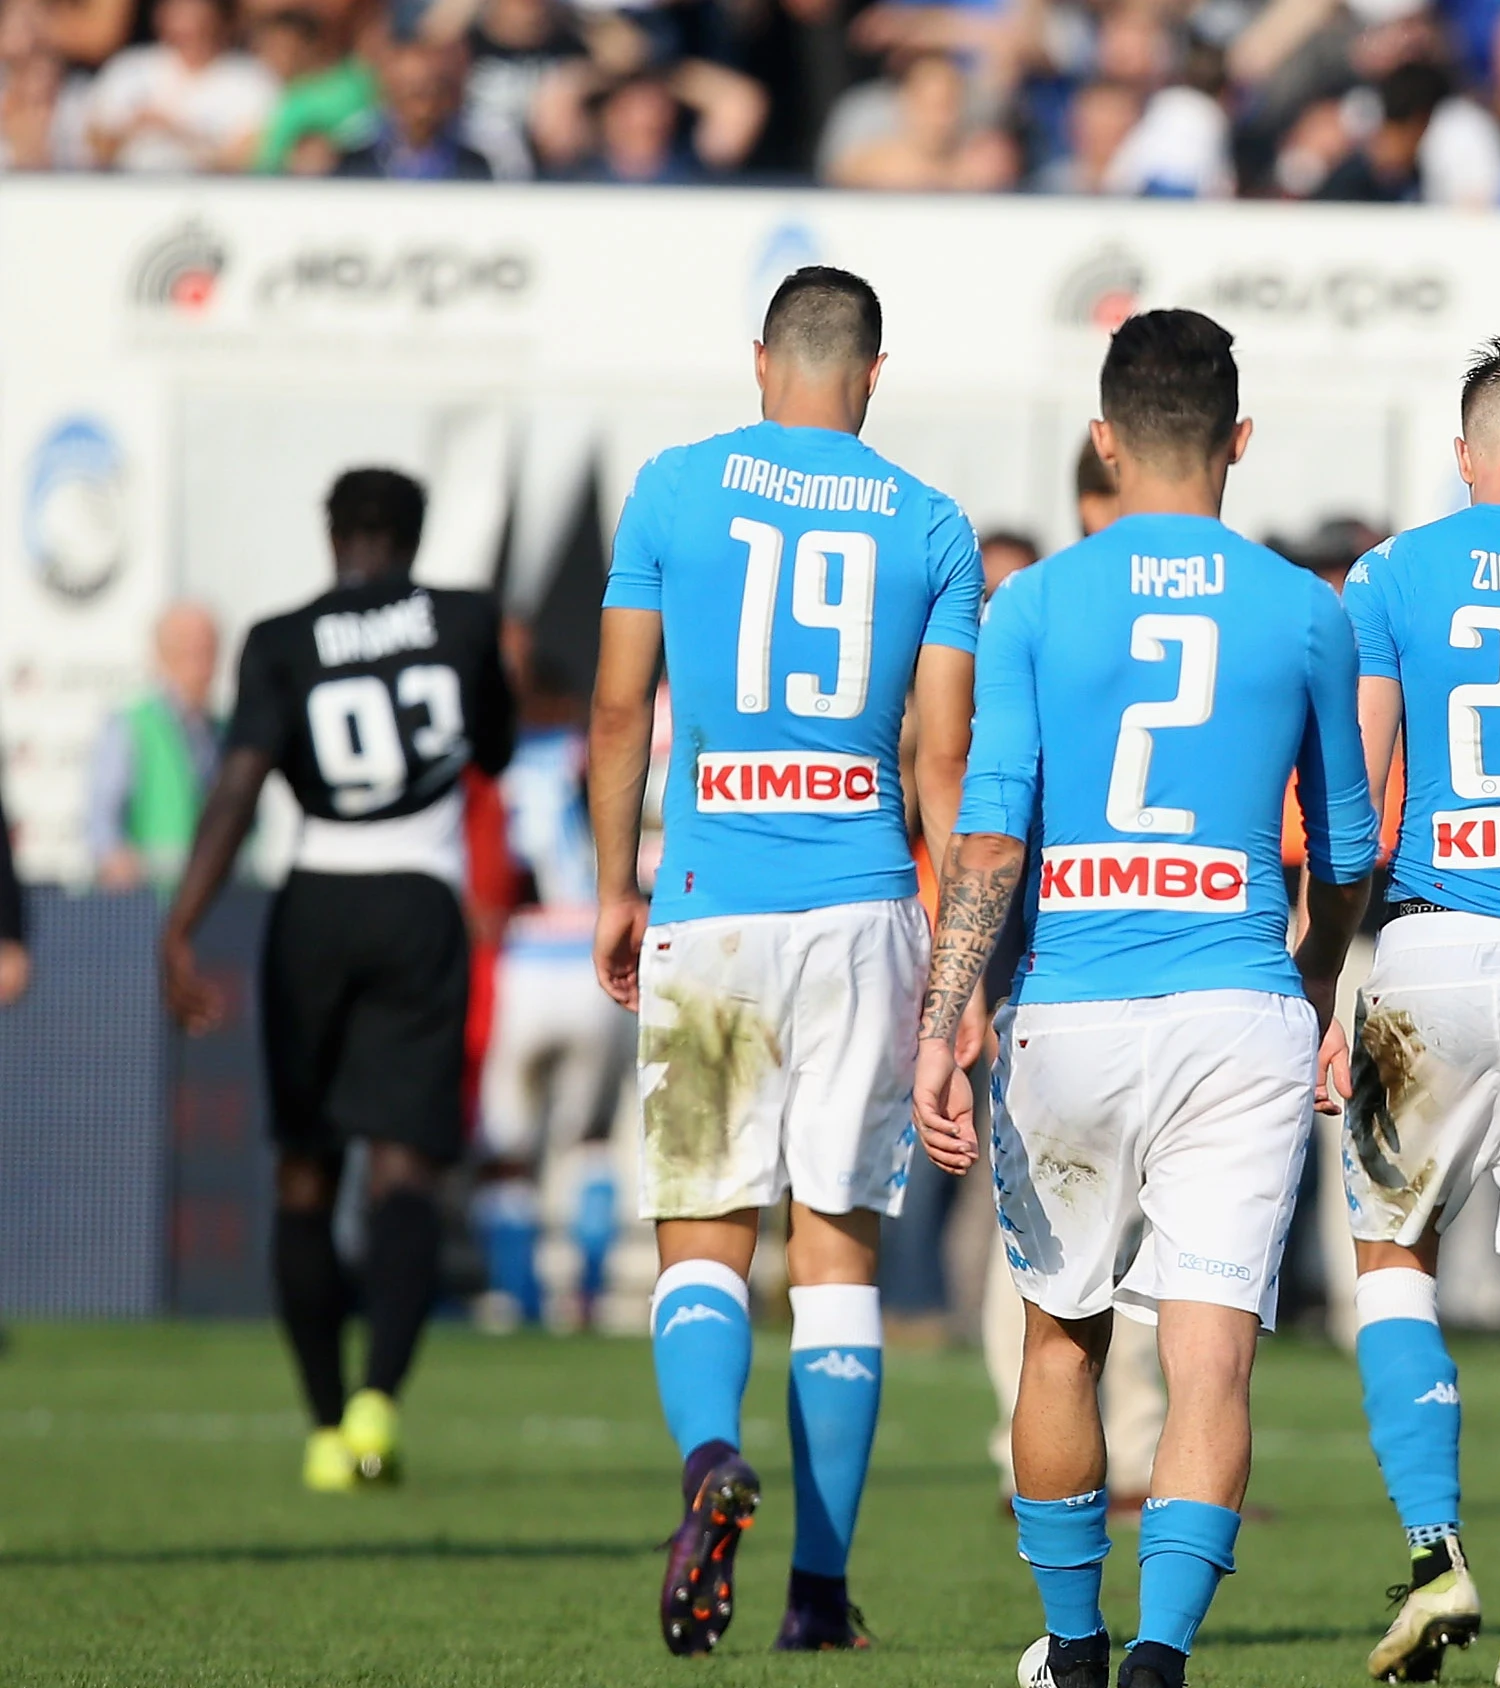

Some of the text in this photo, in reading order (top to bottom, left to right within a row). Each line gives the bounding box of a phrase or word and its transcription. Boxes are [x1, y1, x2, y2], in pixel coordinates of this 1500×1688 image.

[721, 453, 899, 517] MAKSIMOVIĆ
[1130, 553, 1225, 598] HYSAJ
[729, 516, 877, 720] 19
[307, 665, 465, 818] 93
[1105, 613, 1220, 835] 2
[702, 763, 876, 801] KIMBO
[1040, 857, 1244, 901] KIMBO
[1178, 1252, 1250, 1281] Kappa
